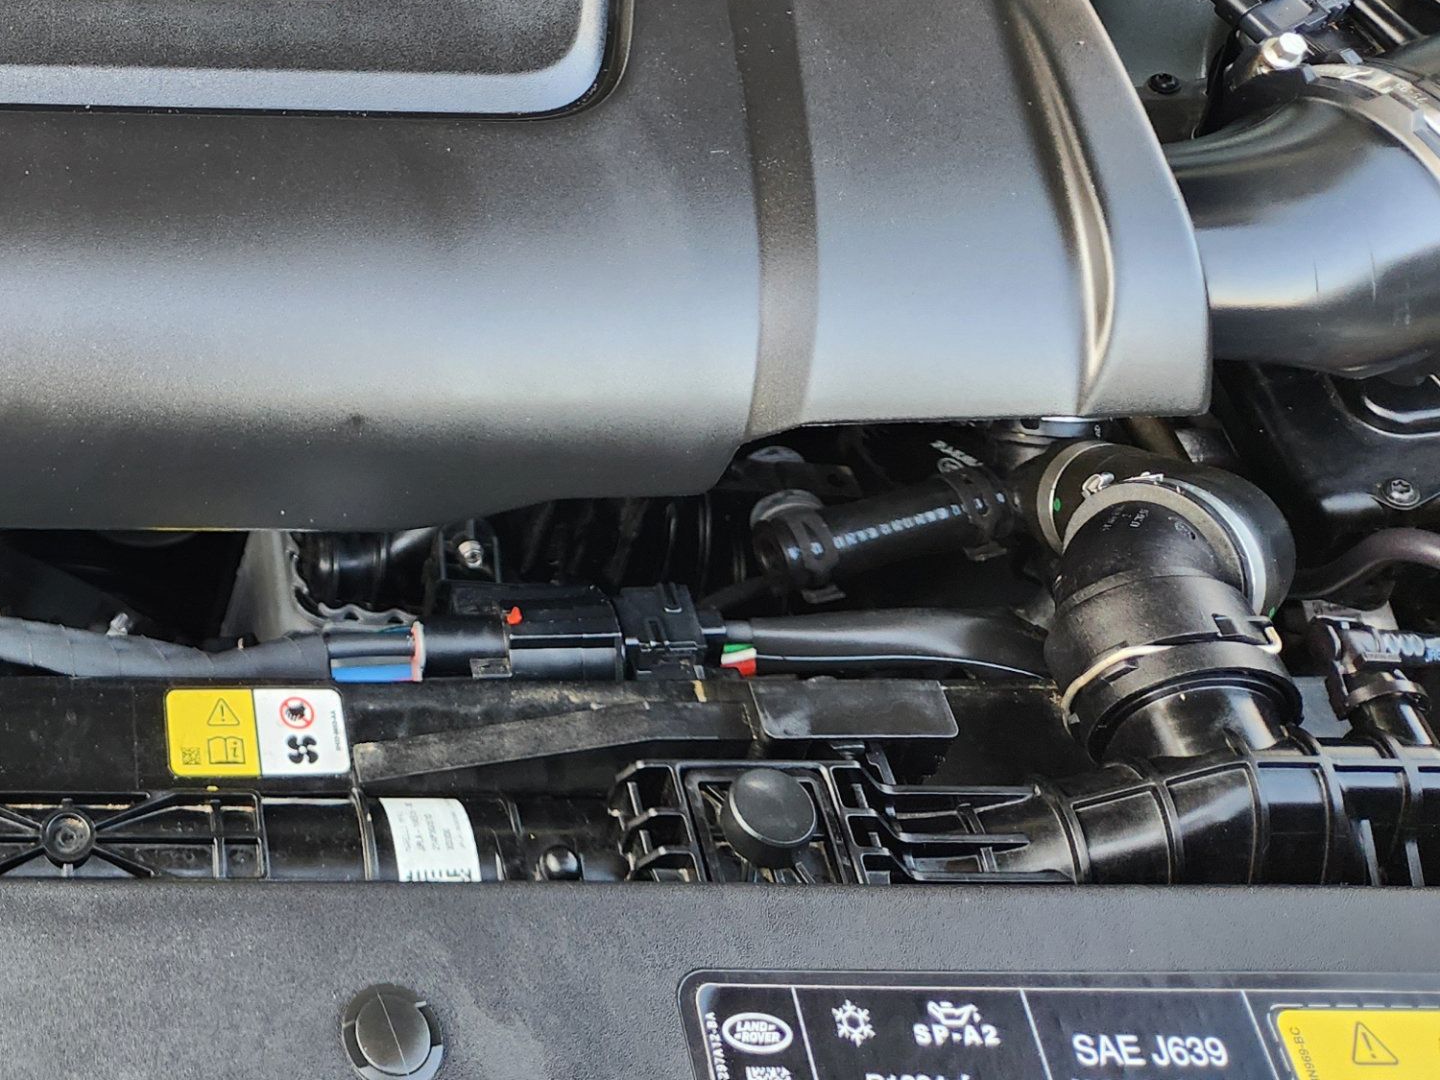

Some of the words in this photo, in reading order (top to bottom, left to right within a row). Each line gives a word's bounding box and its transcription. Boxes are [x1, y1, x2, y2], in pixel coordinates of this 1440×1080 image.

[736, 1020, 768, 1031] LAND
[913, 1023, 1001, 1046] SP-A2
[741, 1031, 780, 1044] ROVER
[1072, 1034, 1146, 1066] SAE
[1151, 1035, 1228, 1067] J639
